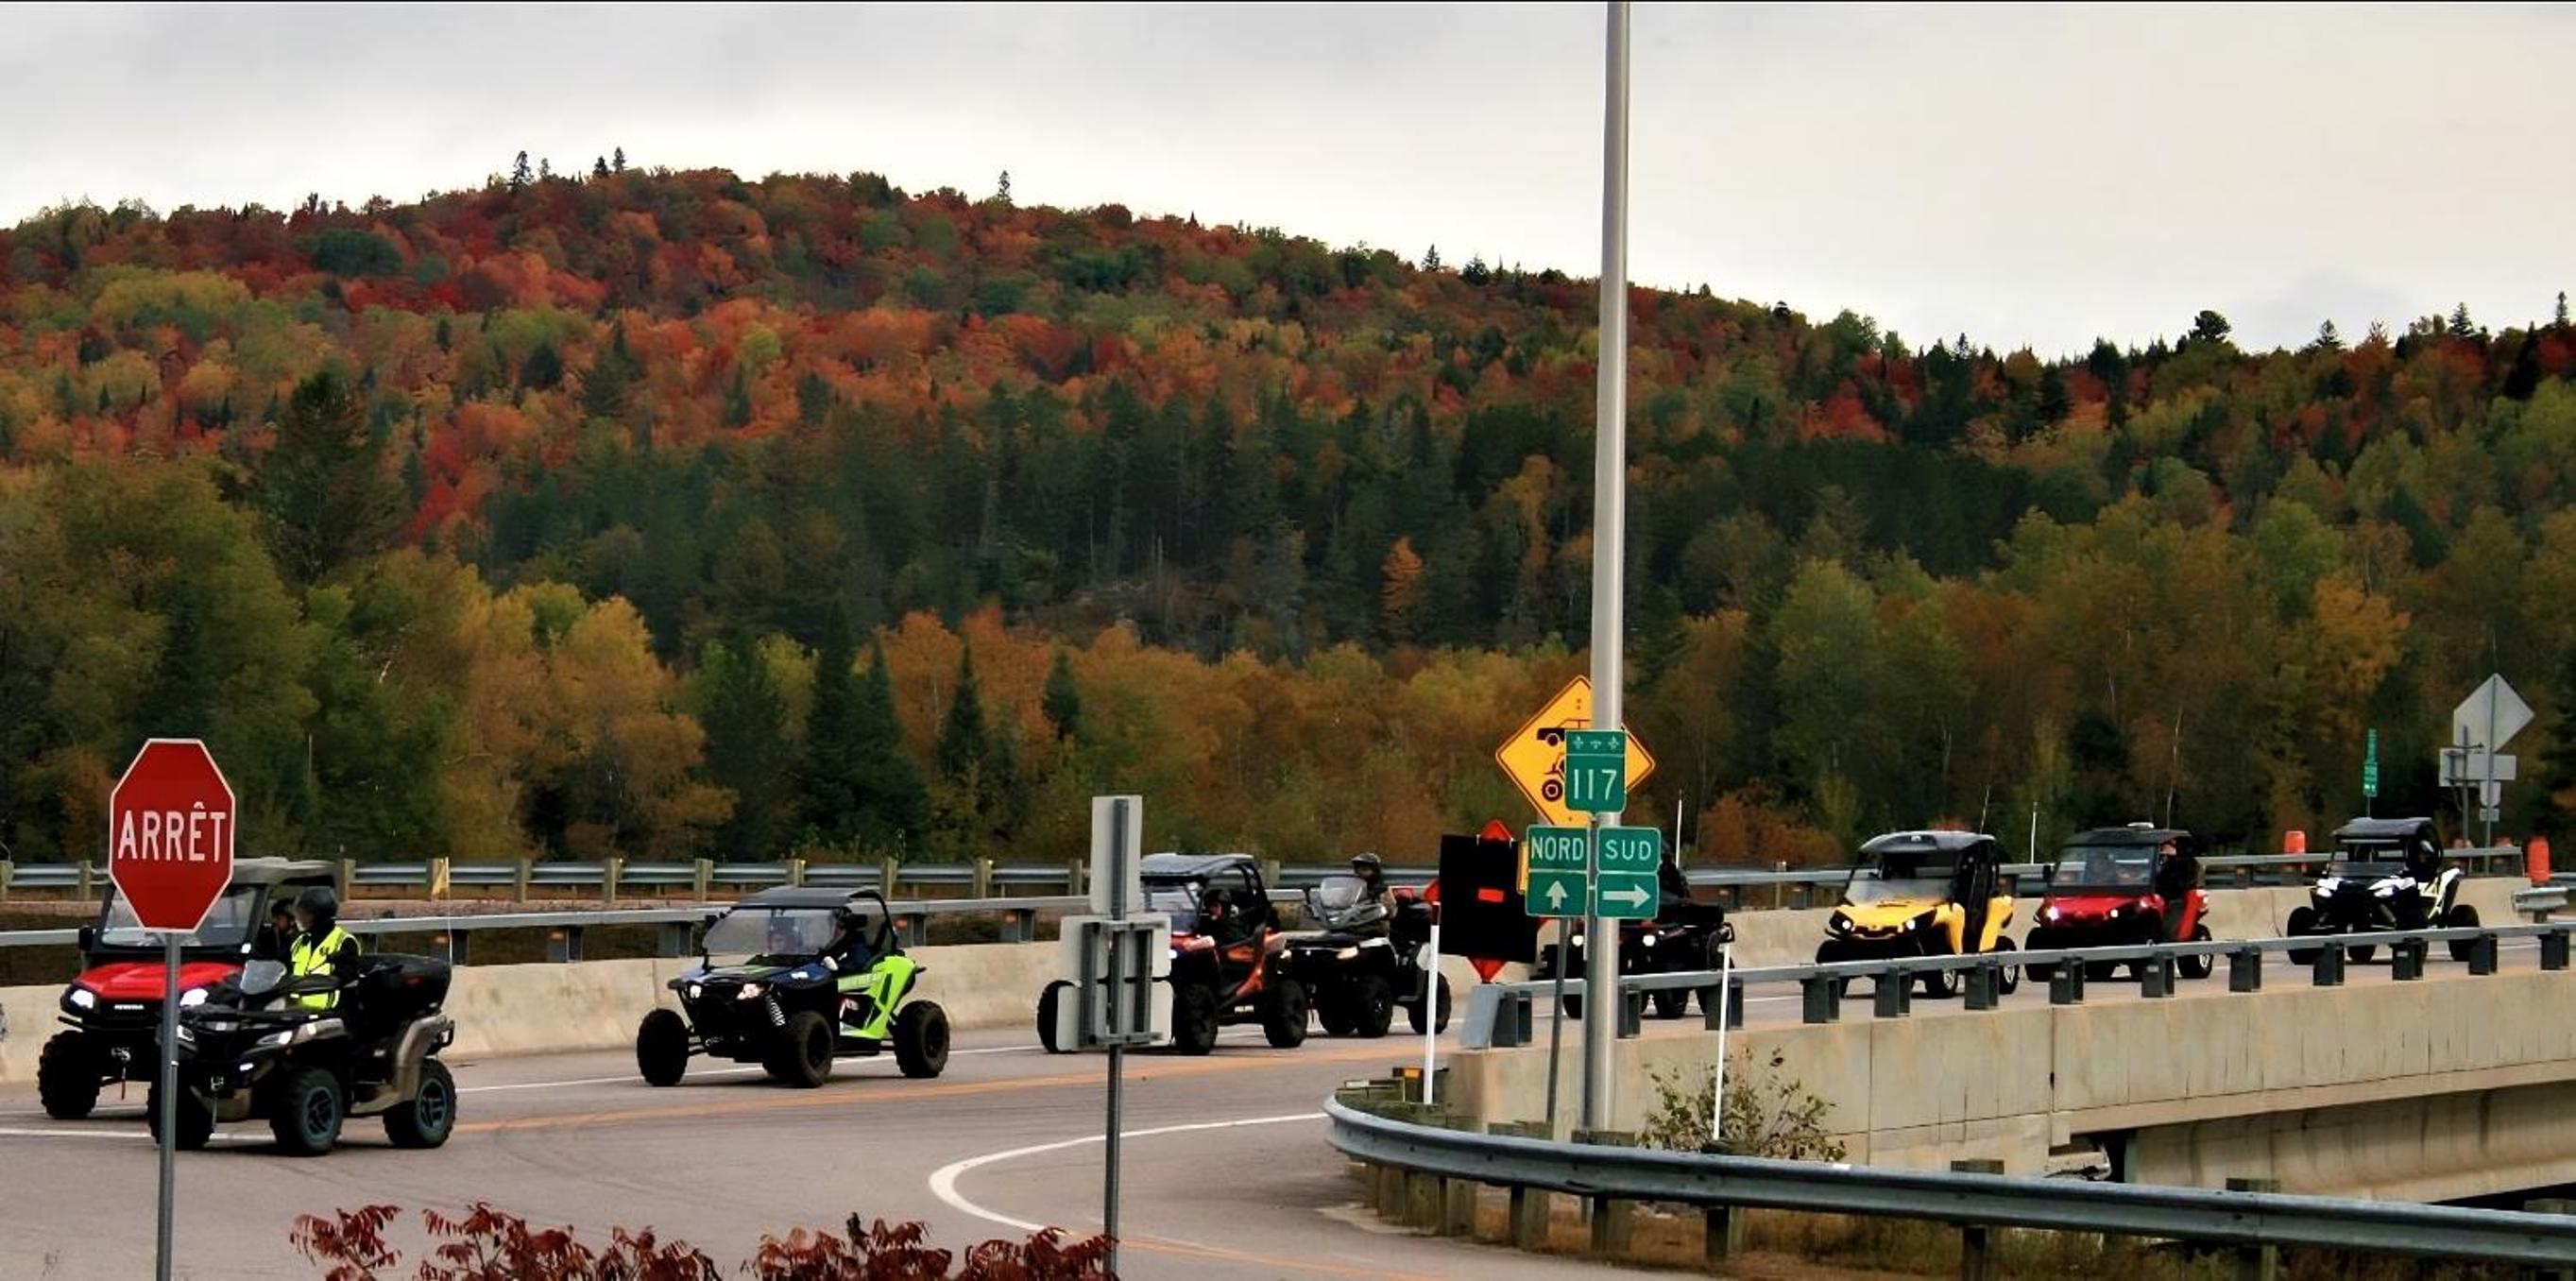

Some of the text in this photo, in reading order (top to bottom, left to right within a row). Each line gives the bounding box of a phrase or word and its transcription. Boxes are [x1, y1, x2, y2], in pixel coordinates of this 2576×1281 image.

[1574, 769, 1616, 800] 117
[118, 801, 226, 863] ARRÊT
[1531, 836, 1584, 861] NORD
[1605, 840, 1651, 861] SUD
